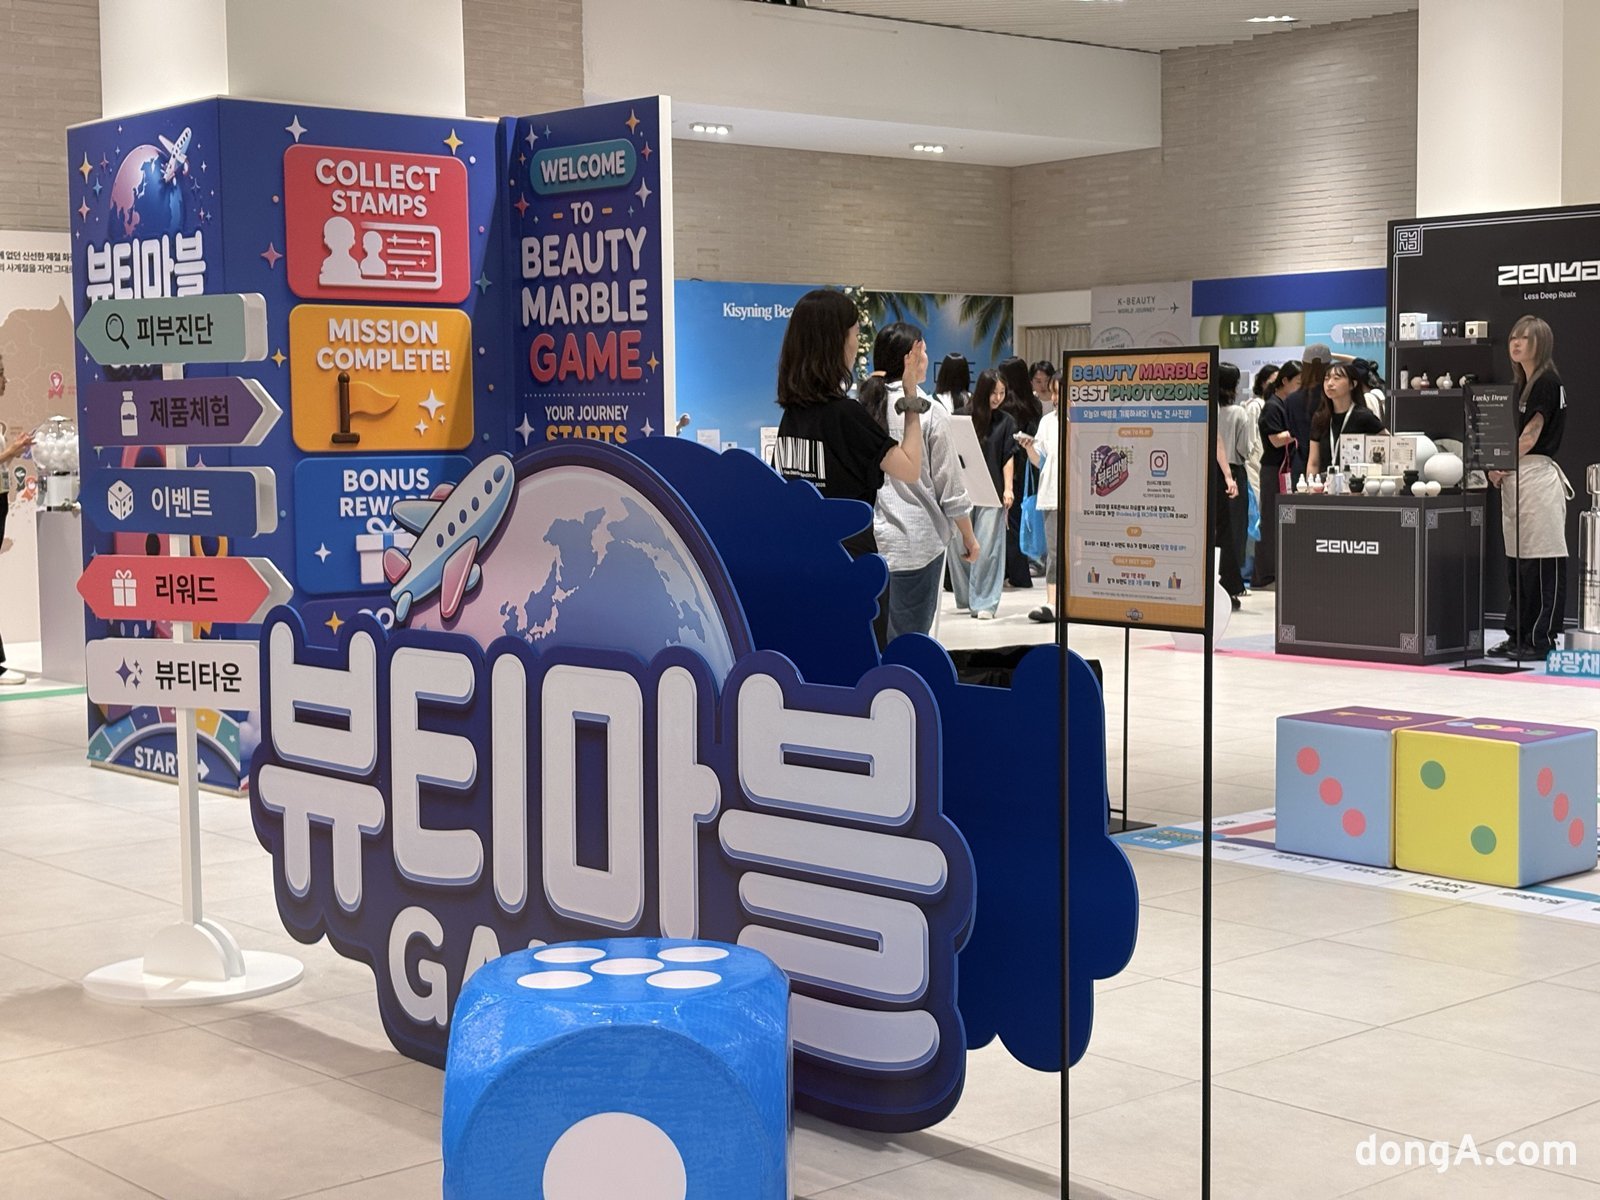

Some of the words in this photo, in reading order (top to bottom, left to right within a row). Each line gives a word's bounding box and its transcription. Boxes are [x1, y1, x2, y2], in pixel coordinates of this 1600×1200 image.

[315, 158, 441, 192] COLLECT
[540, 149, 626, 184] WELCOME
[331, 190, 428, 217] STAMPS
[570, 202, 594, 225] TO
[86, 230, 206, 301] 뷰티마블
[521, 226, 647, 280] BEAUTY
[54, 264, 72, 274] 그대
[521, 278, 648, 326] MARBLE
[1117, 296, 1156, 306] K-BEAUTY
[1523, 292, 1539, 300] Less
[1540, 291, 1558, 300] Deep
[723, 302, 773, 321] Kisyning
[1135, 306, 1156, 314] JOURNEY
[136, 313, 214, 347] 피부진단
[328, 318, 438, 345] MISSION
[1230, 320, 1260, 335] LBB
[316, 346, 451, 372] COMPLETE!
[529, 330, 643, 383] GAME
[1072, 364, 1137, 382] BEAUTY
[1138, 362, 1209, 381] MARBLE
[1069, 384, 1110, 402] BEST
[1109, 383, 1210, 402] PHOTOZONE
[1472, 394, 1490, 403] Lucky
[1491, 393, 1509, 402] Draw
[150, 395, 230, 429] 제품체험
[545, 405, 574, 421] YOUR
[577, 405, 629, 421] JOURNEY
[343, 468, 430, 493] BONUS
[151, 486, 213, 518] 이벤트
[155, 574, 218, 605] 리워드
[155, 660, 242, 693] 뷰티타운
[134, 745, 179, 776] STAR
[258, 621, 948, 1072] 뷰티마블
